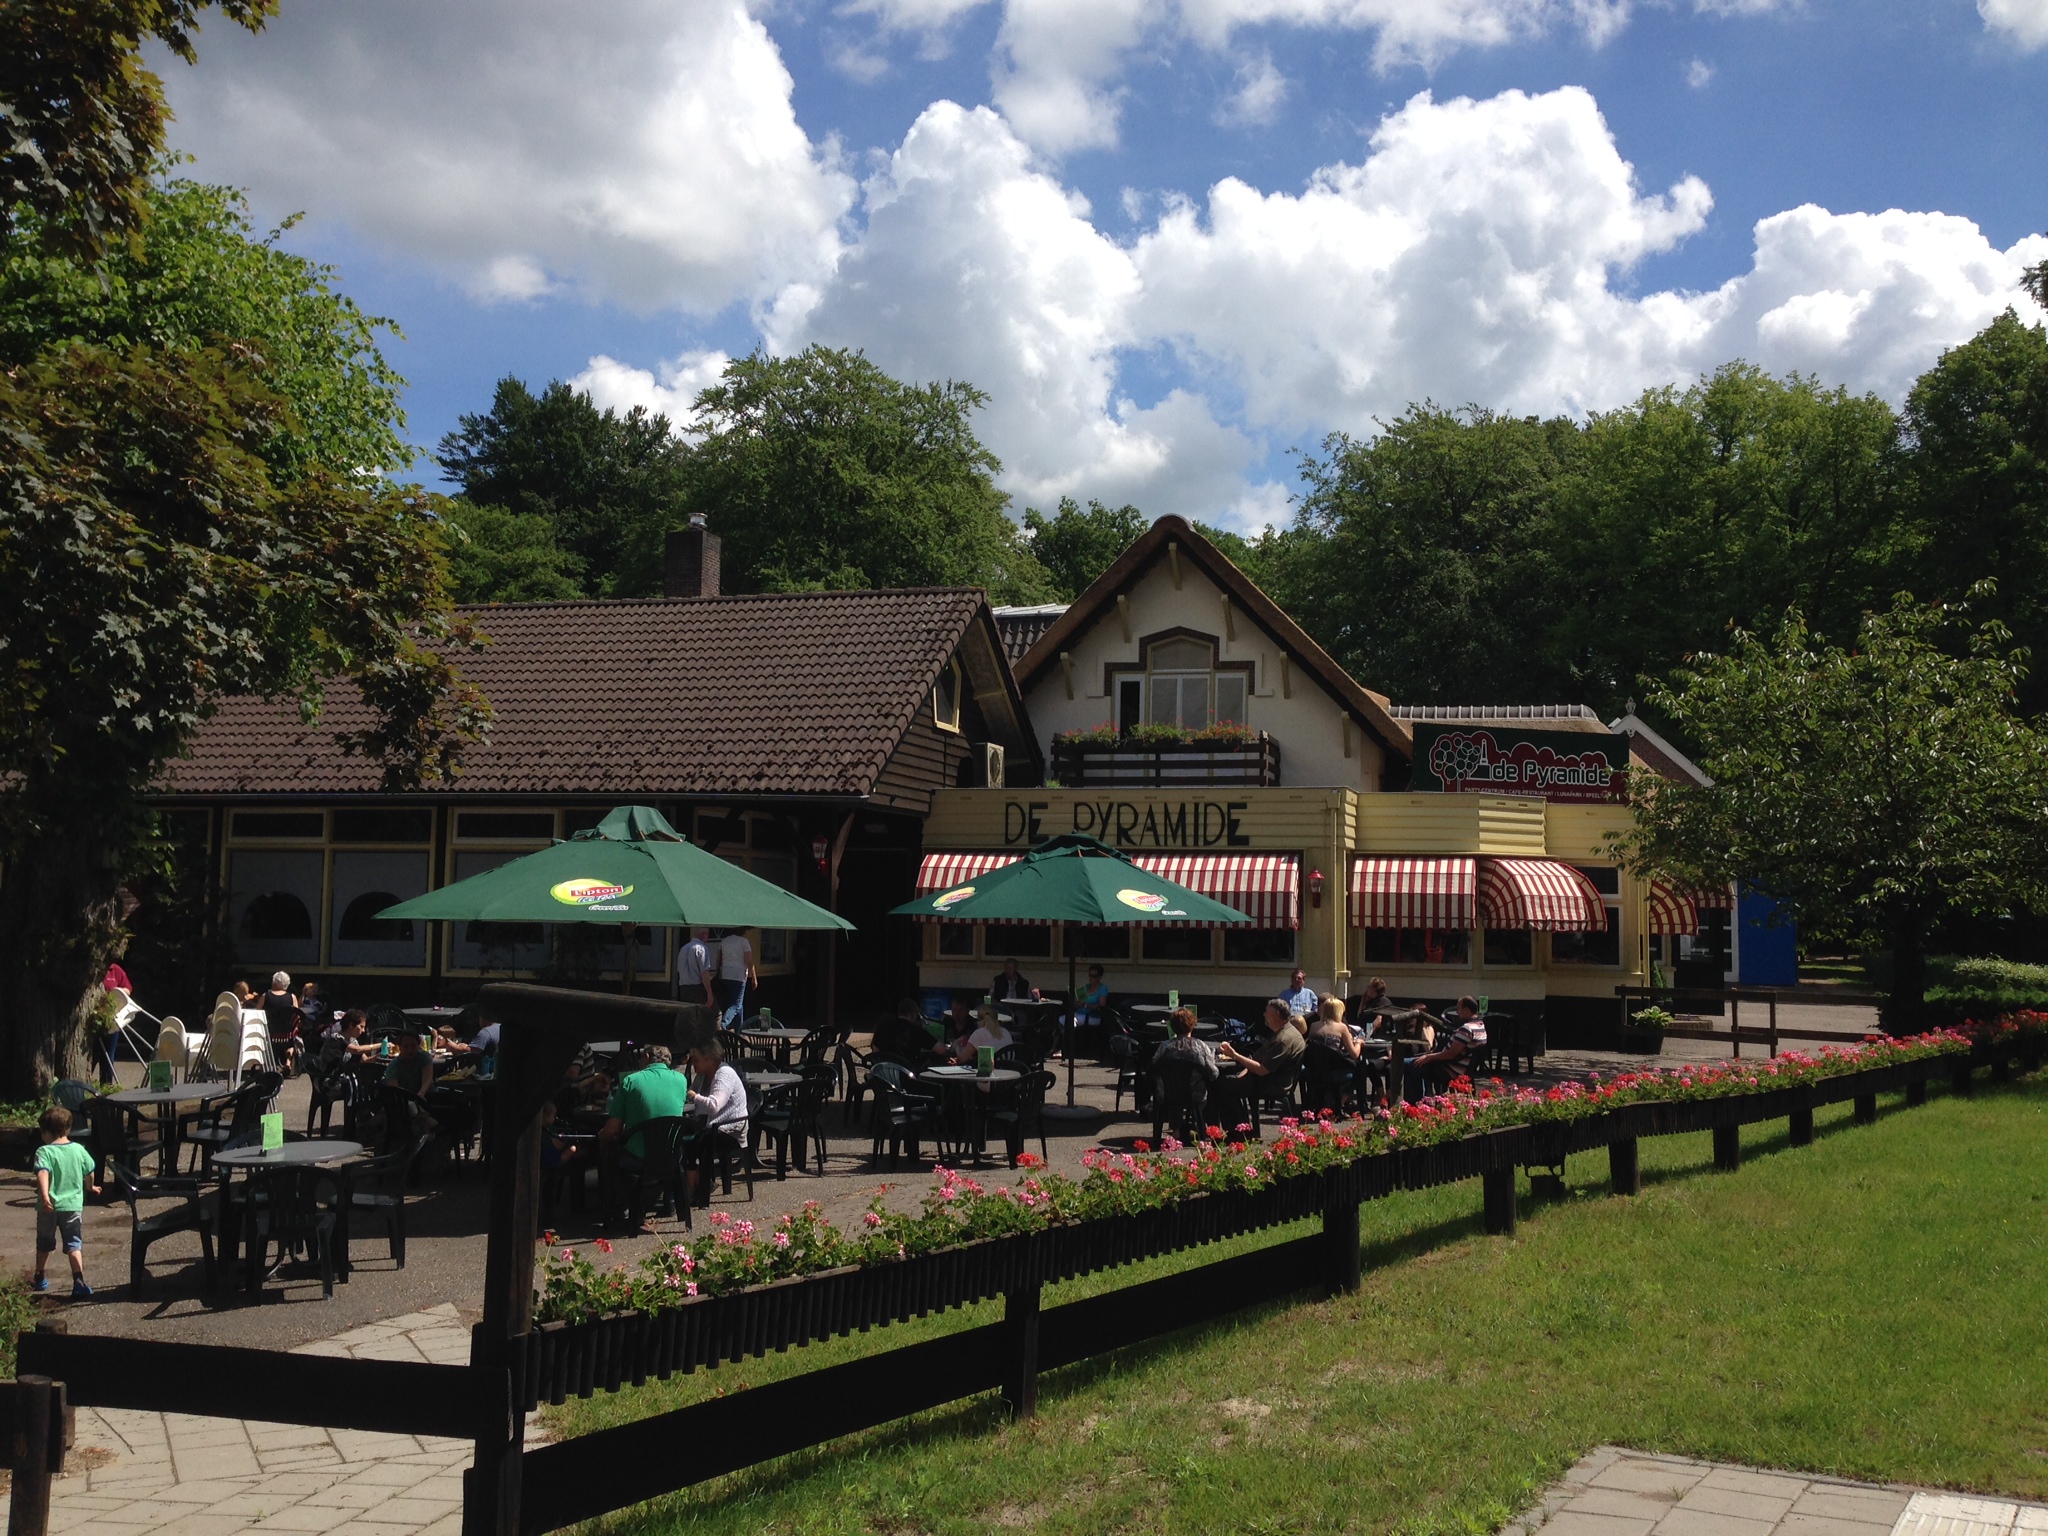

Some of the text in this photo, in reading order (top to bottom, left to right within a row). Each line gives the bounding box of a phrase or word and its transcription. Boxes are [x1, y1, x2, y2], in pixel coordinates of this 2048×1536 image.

[1492, 759, 1611, 788] de Pyramide
[1004, 802, 1250, 846] DE PYRAMIDE
[574, 887, 619, 896] Lipton
